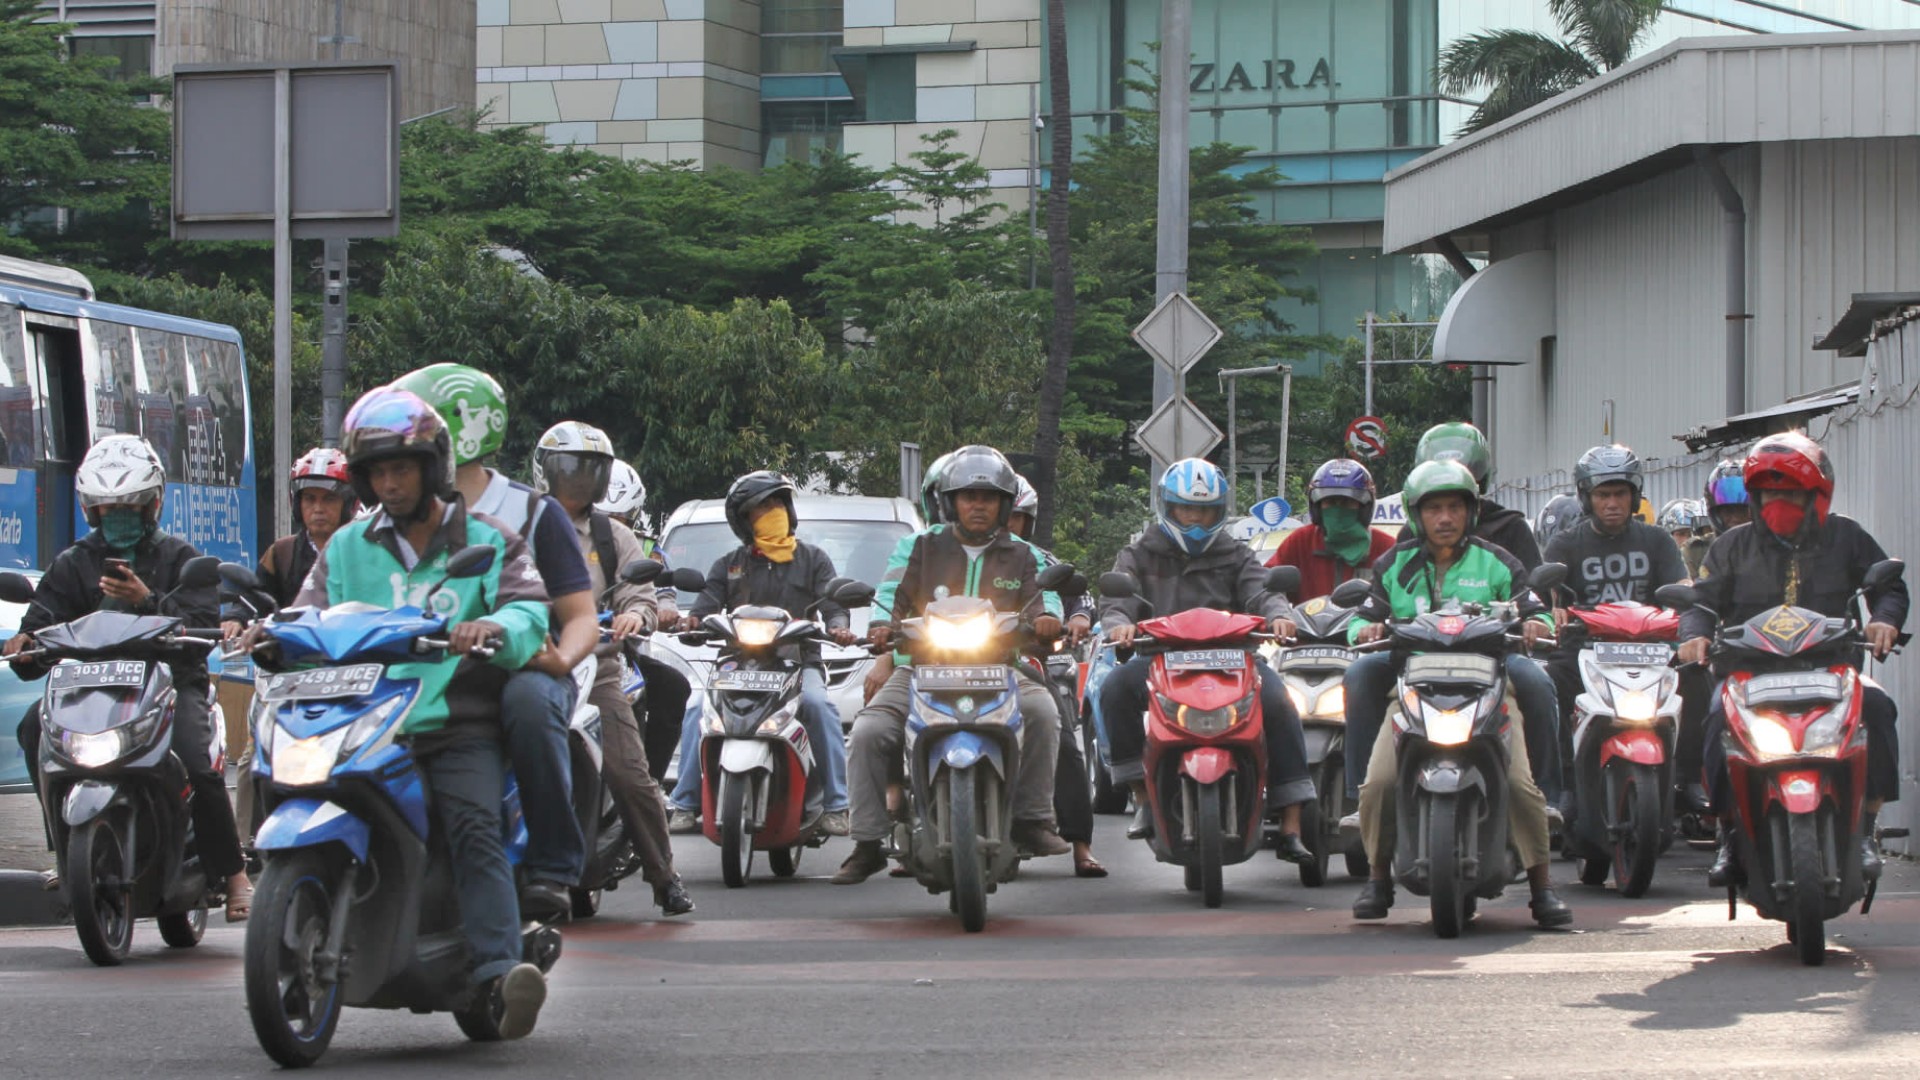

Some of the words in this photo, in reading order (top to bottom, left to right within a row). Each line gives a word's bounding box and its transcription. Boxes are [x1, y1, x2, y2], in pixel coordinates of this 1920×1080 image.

[1190, 57, 1341, 92] ZARA
[1582, 551, 1650, 581] GOD
[993, 577, 1021, 590] Grab
[1584, 580, 1649, 604] SAVE
[53, 667, 63, 679] B
[73, 663, 110, 675] 3037
[116, 662, 143, 674] UCC
[269, 676, 285, 688] B
[294, 670, 337, 685] 3498
[342, 666, 377, 680] UCE
[760, 673, 782, 682] UAX
